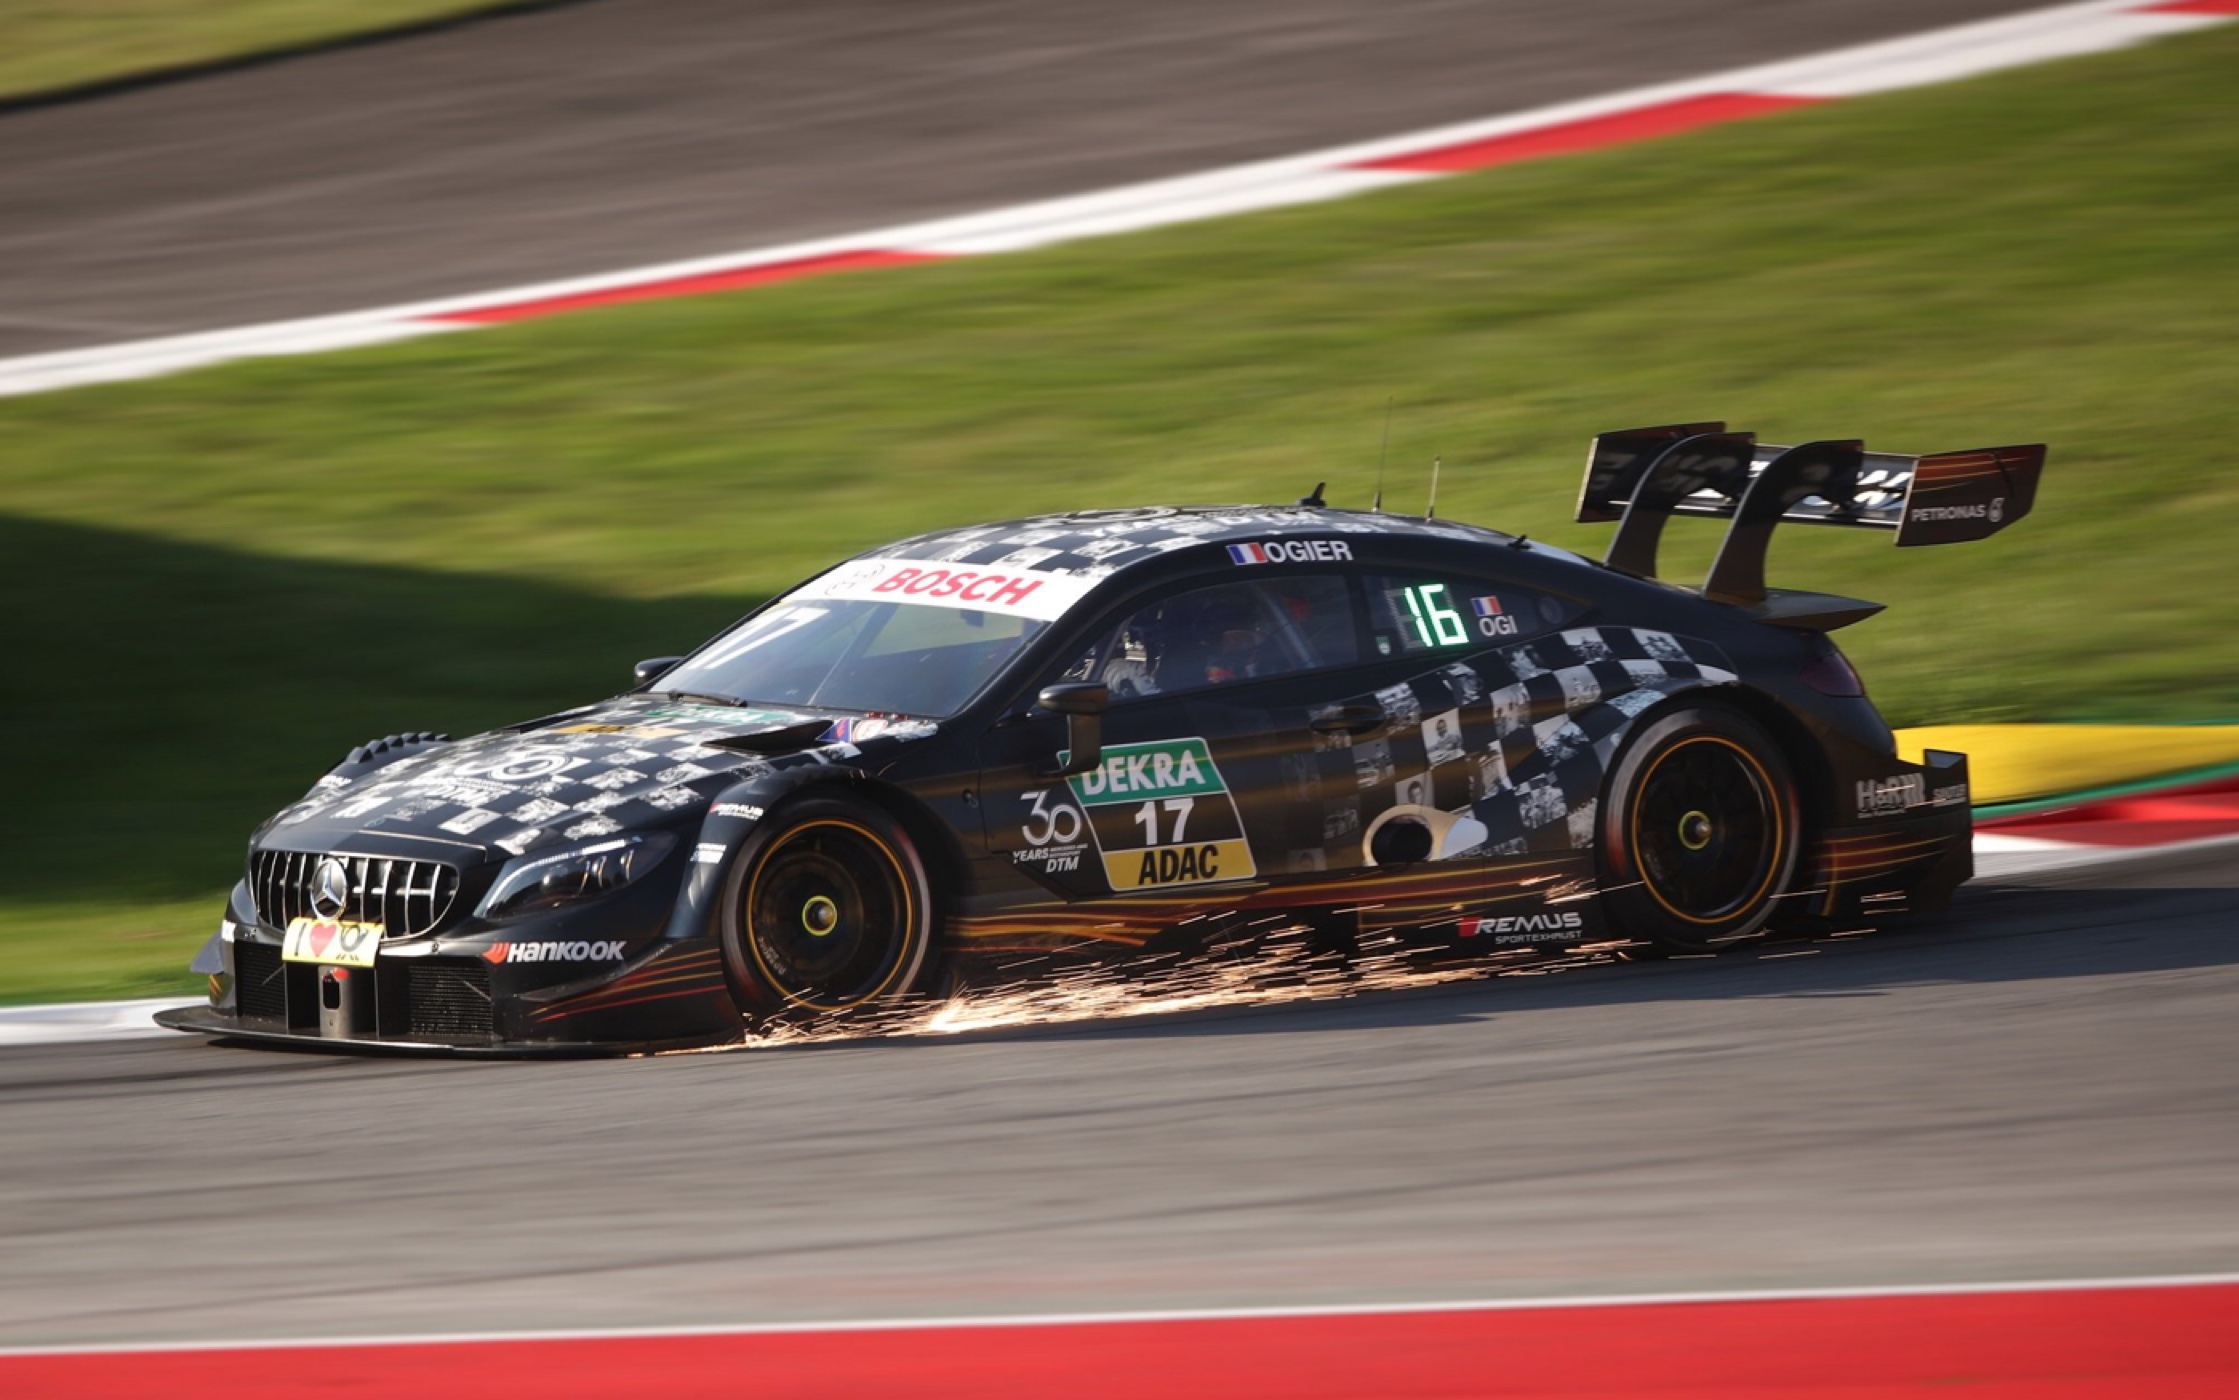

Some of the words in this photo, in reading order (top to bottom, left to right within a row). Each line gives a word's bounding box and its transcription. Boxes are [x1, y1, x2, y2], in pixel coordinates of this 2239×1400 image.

[1911, 504, 1986, 522] PETRONAS
[1263, 541, 1353, 563] OGIER
[872, 567, 1044, 606] BOSCH
[1403, 583, 1469, 647] 16
[1479, 615, 1518, 636] OGI
[688, 606, 831, 670] 17
[1081, 749, 1206, 796] DEKRA
[1020, 788, 1082, 846] 30
[1134, 796, 1194, 847] 17
[1012, 847, 1049, 864] YEARS
[1045, 855, 1080, 874] DTM
[1138, 844, 1219, 886] ADAC
[1475, 911, 1582, 934] REMUS
